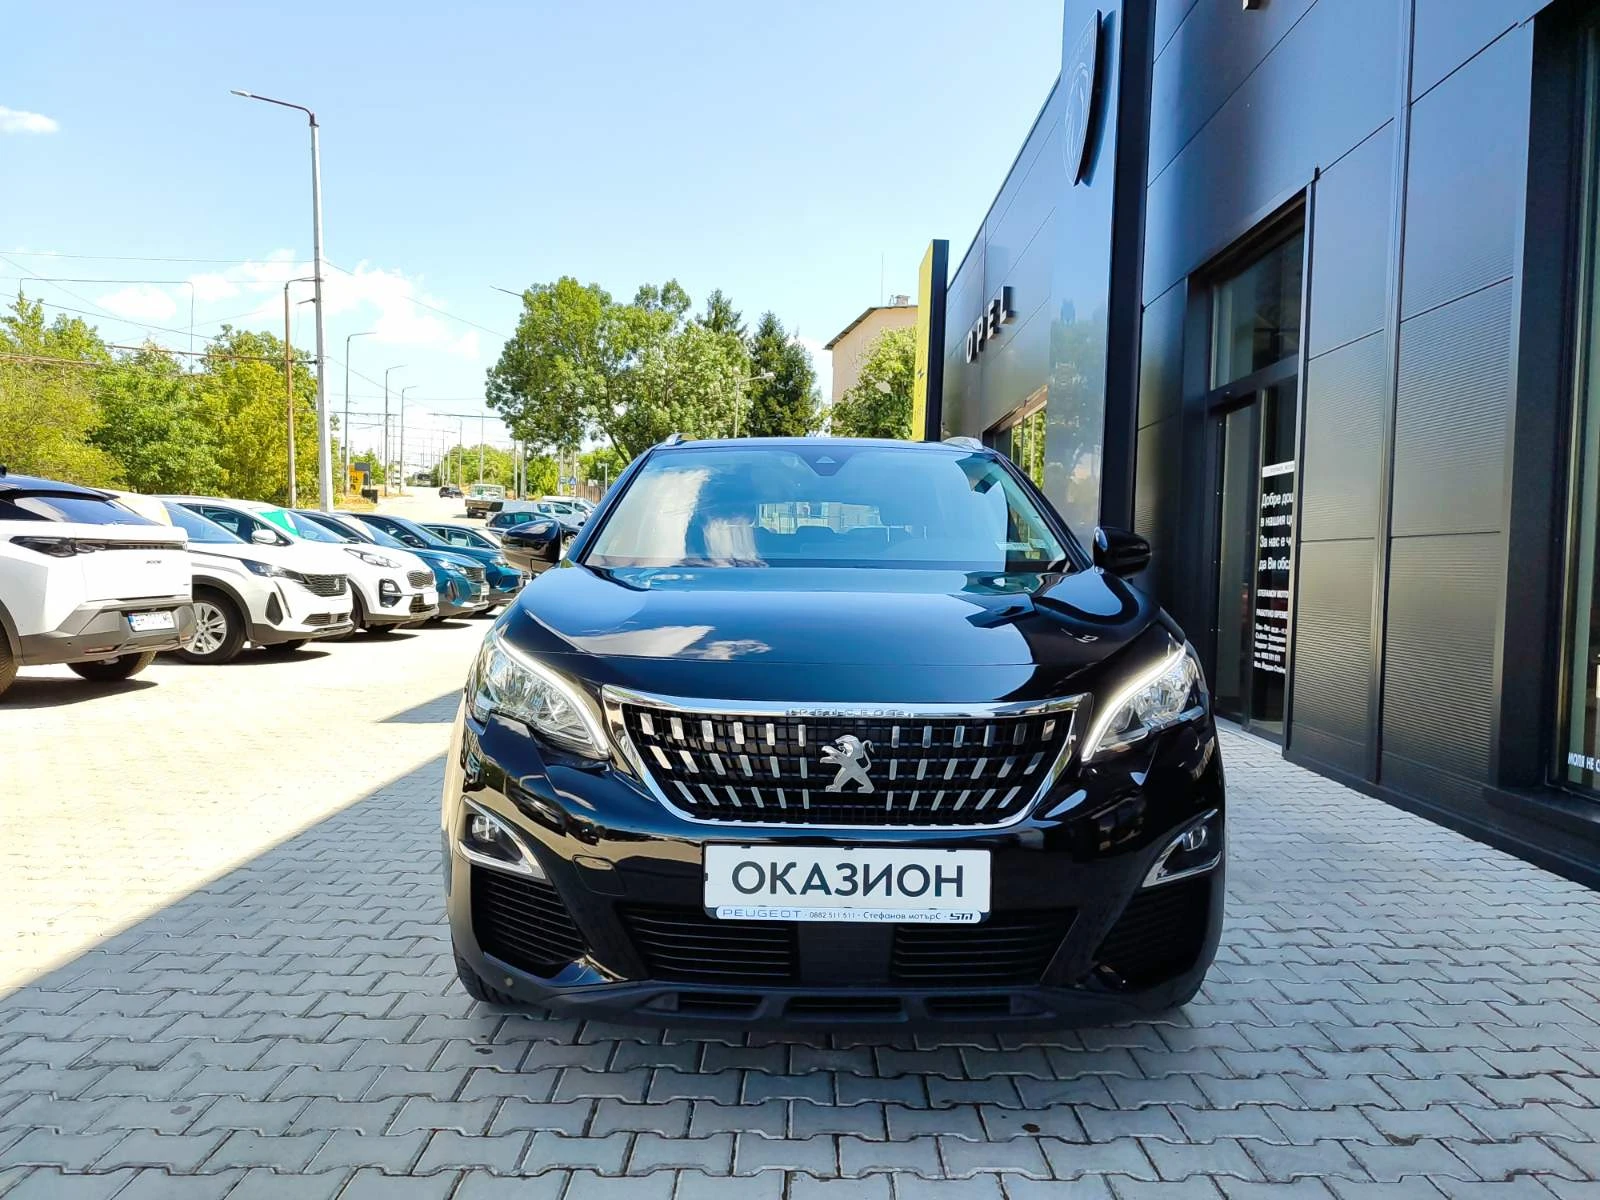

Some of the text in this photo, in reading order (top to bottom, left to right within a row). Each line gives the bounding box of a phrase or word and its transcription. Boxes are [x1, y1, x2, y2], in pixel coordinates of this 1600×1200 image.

[966, 285, 1012, 364] OPEL
[1261, 492, 1281, 508] Добре
[1259, 535, 1268, 548] За
[731, 860, 964, 898] ОКАЗИОН
[722, 908, 802, 919] PEUGEOT
[863, 911, 906, 921] Стефанов
